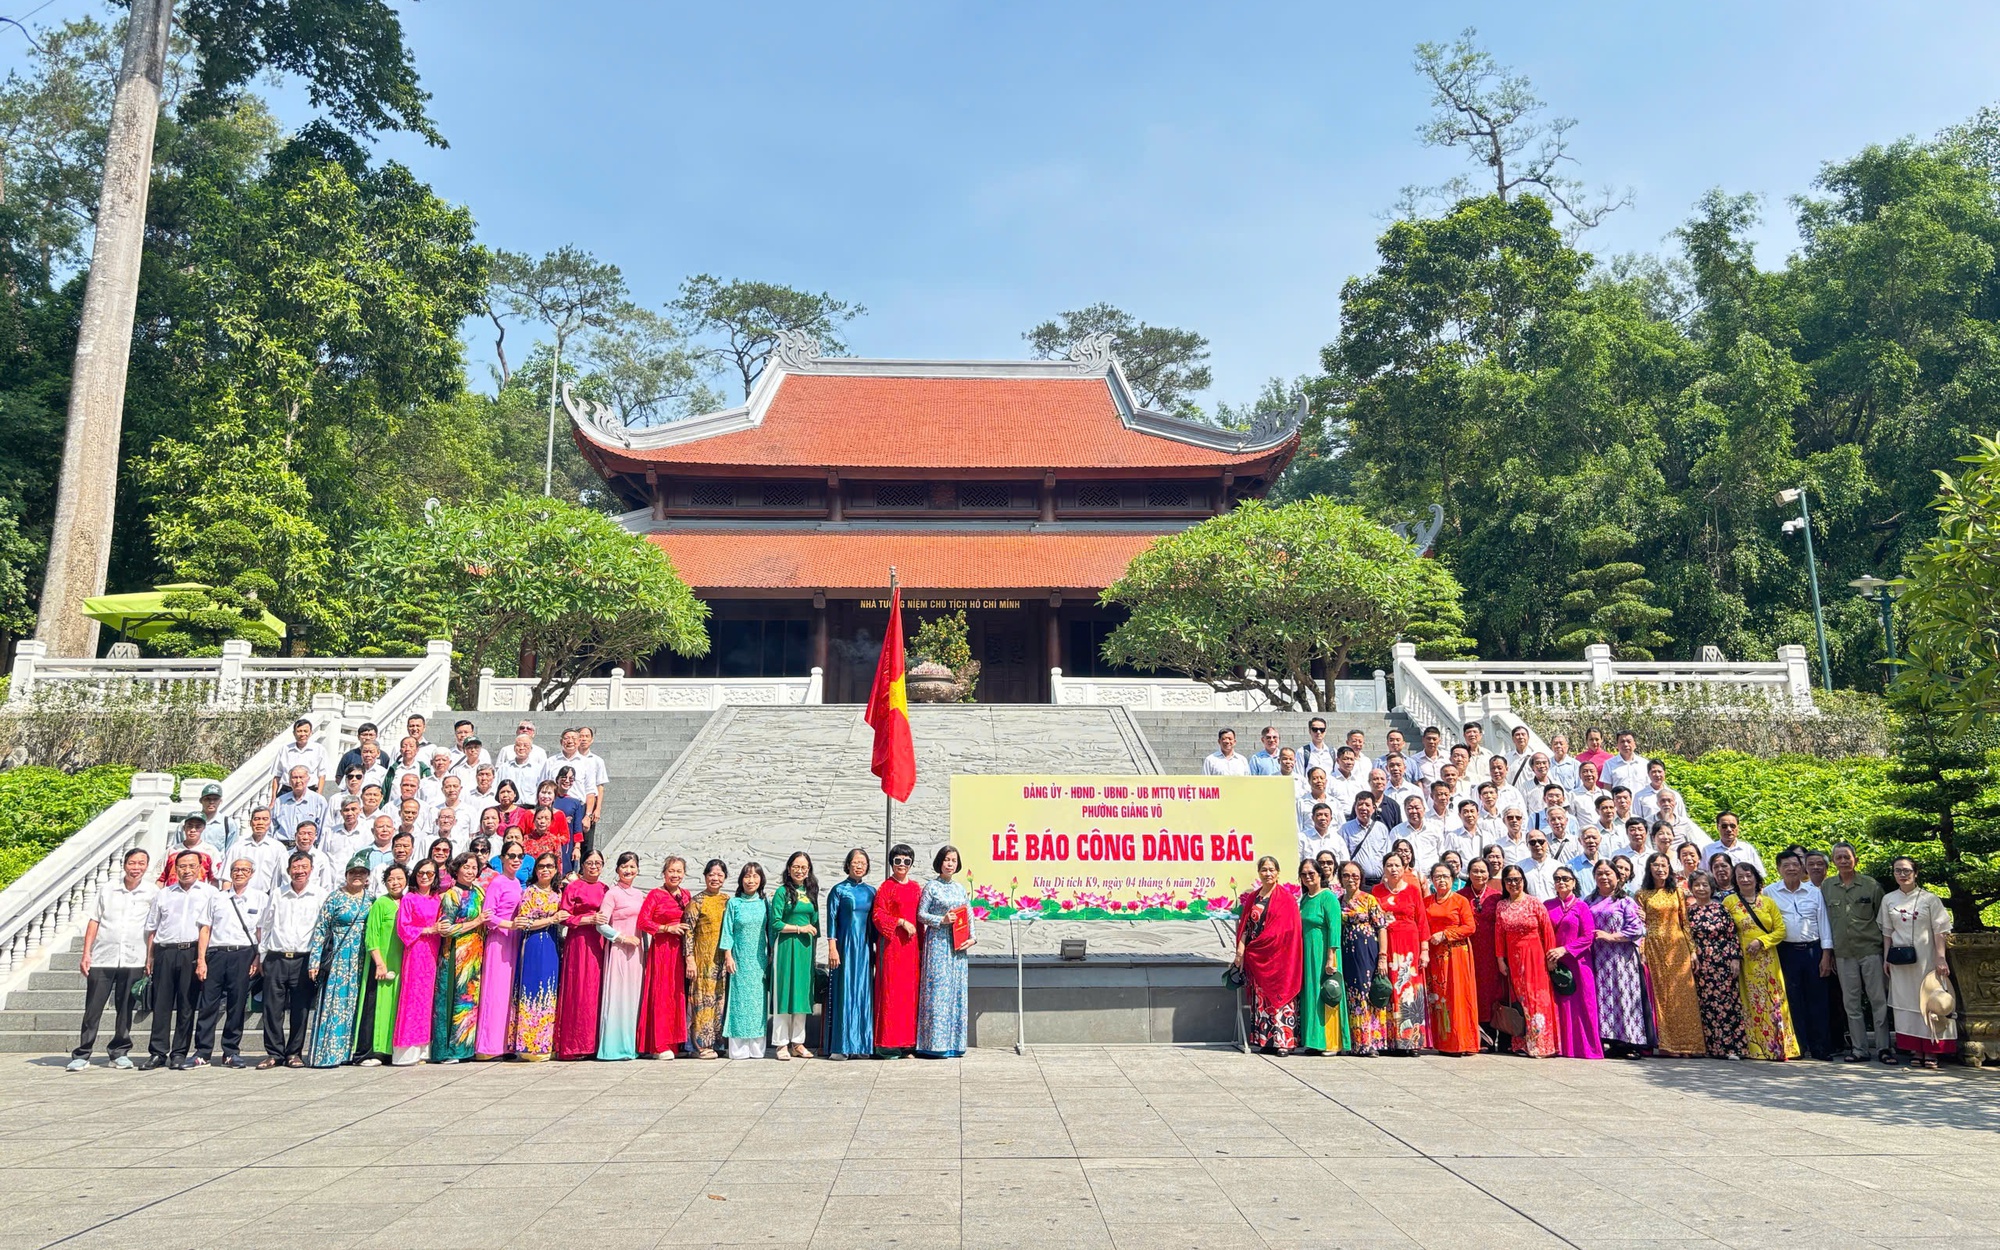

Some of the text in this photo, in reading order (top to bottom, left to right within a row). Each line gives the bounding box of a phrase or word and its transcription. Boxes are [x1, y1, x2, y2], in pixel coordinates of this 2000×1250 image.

[860, 598, 877, 609] NHÀ
[1023, 782, 1048, 799] ĐẢNG
[1051, 782, 1062, 799] ỦY
[1070, 786, 1095, 799] HĐND
[1104, 786, 1128, 799] UBND
[1137, 786, 1149, 799] UB
[1151, 786, 1175, 800] MTTQ
[1178, 784, 1196, 802] VIỆT
[1199, 786, 1220, 799] NAM
[1082, 801, 1162, 818] PHƯỜNG GIẢNG VÕ
[992, 823, 1254, 861] LỄ BÁO CÔNG DÂNG BÁC
[1033, 876, 1216, 890] Khu Di tích K9, ngày 04 tháng 6 năm 2026
